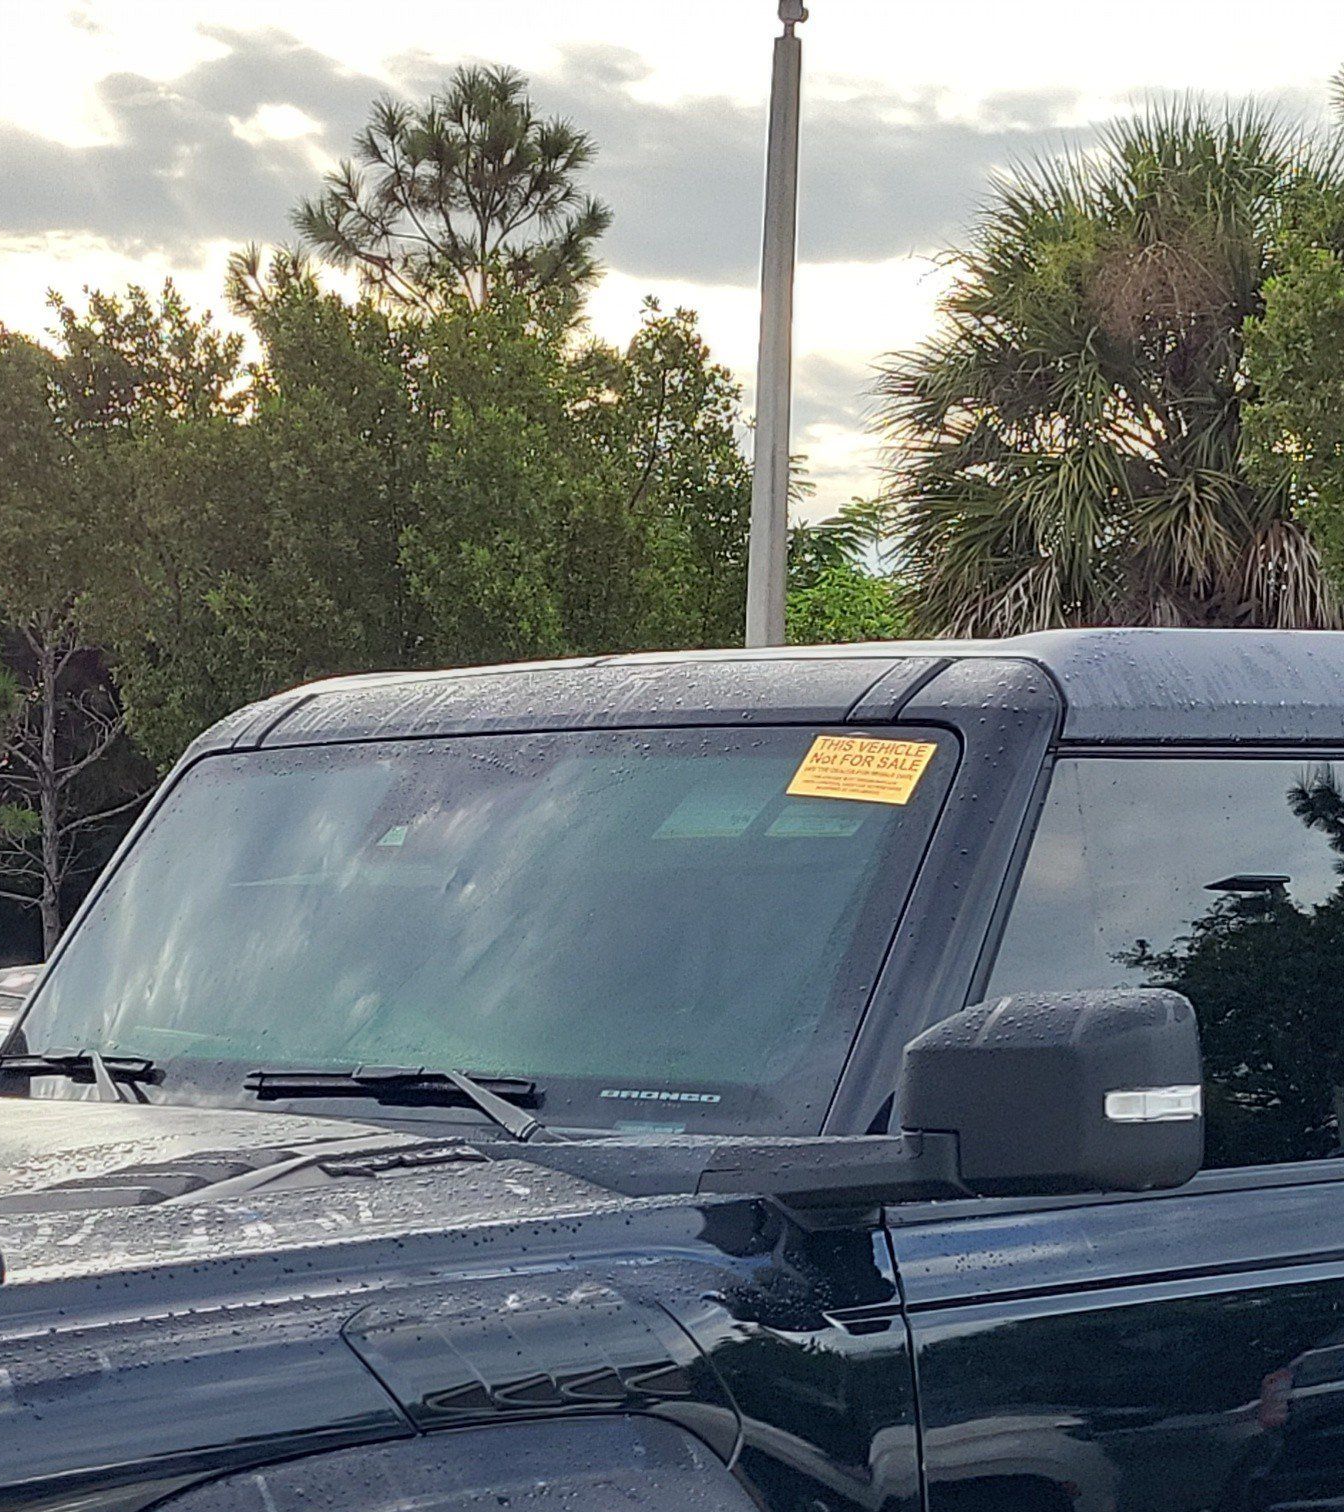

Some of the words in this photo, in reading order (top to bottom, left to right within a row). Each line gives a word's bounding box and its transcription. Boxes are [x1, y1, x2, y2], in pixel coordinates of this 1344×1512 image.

[819, 738, 855, 752] THIS
[858, 741, 928, 758] VEHICLE
[839, 754, 876, 768] FOR
[876, 756, 923, 772] SALE
